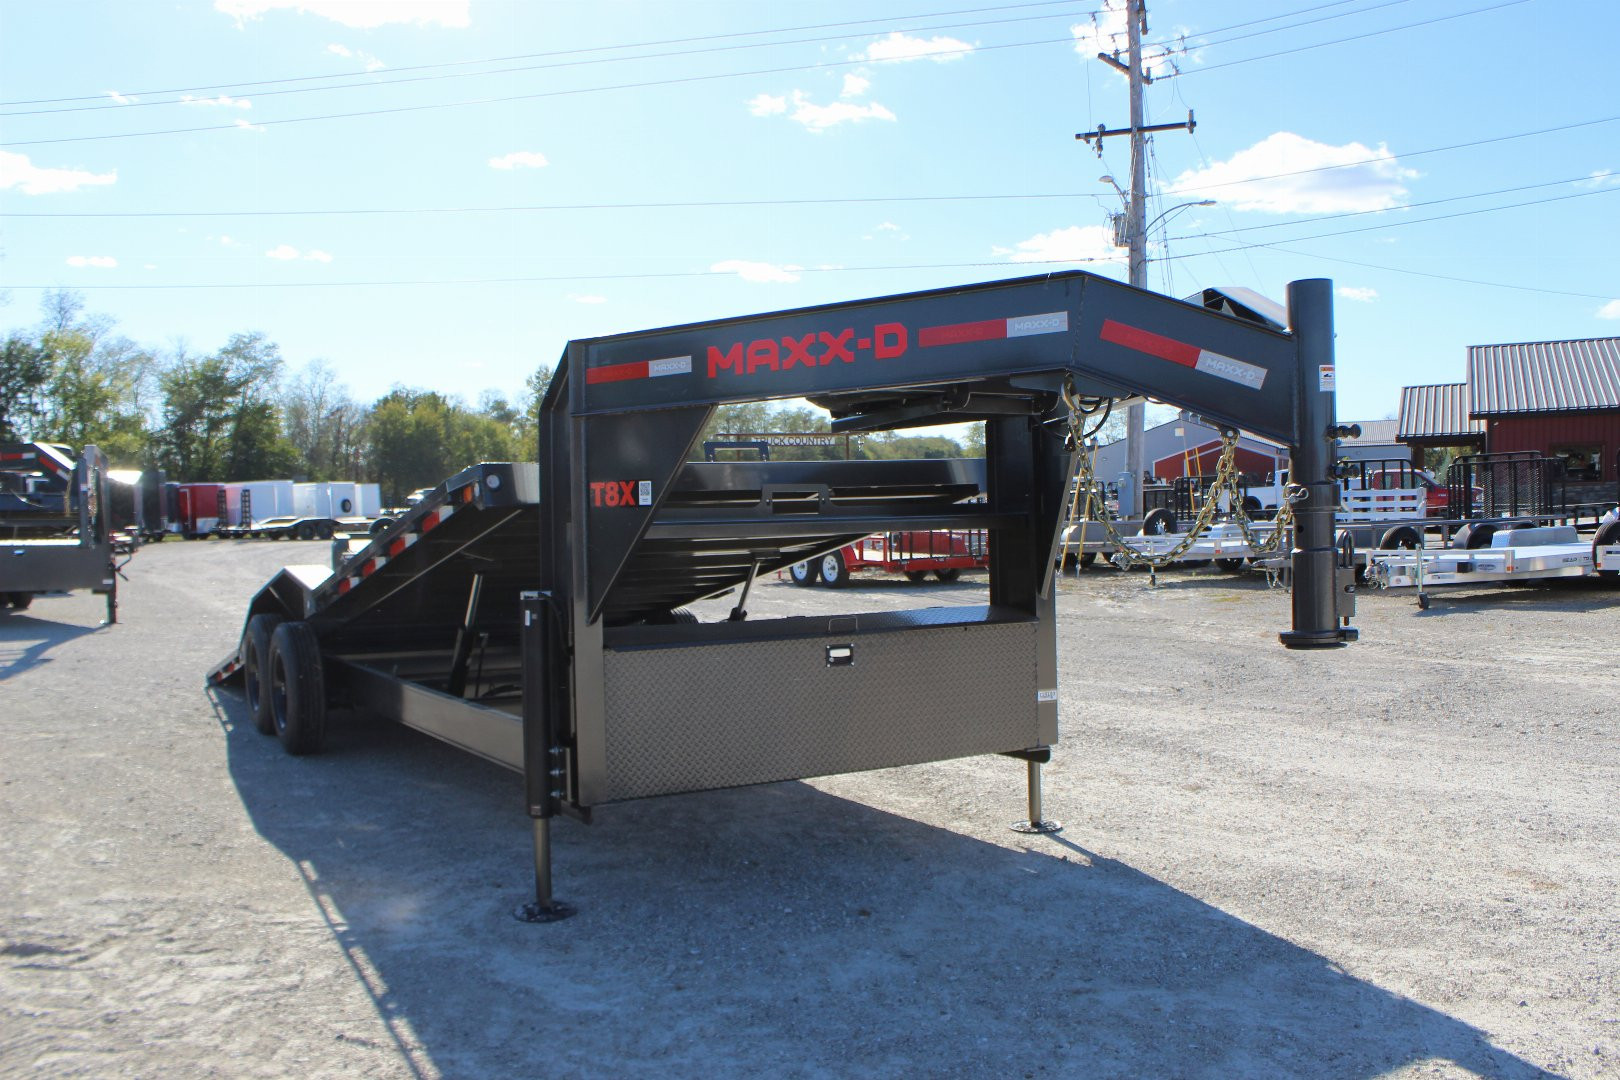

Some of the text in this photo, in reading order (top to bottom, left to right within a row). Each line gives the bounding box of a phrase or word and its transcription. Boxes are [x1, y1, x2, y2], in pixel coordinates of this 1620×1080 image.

[1014, 318, 1060, 331] MAXX-D
[707, 322, 908, 378] MAXX-D
[654, 361, 687, 373] MAXX-D
[1206, 357, 1256, 381] MAXX-D
[787, 436, 833, 446] COUNTRY
[589, 481, 636, 507] T8X
